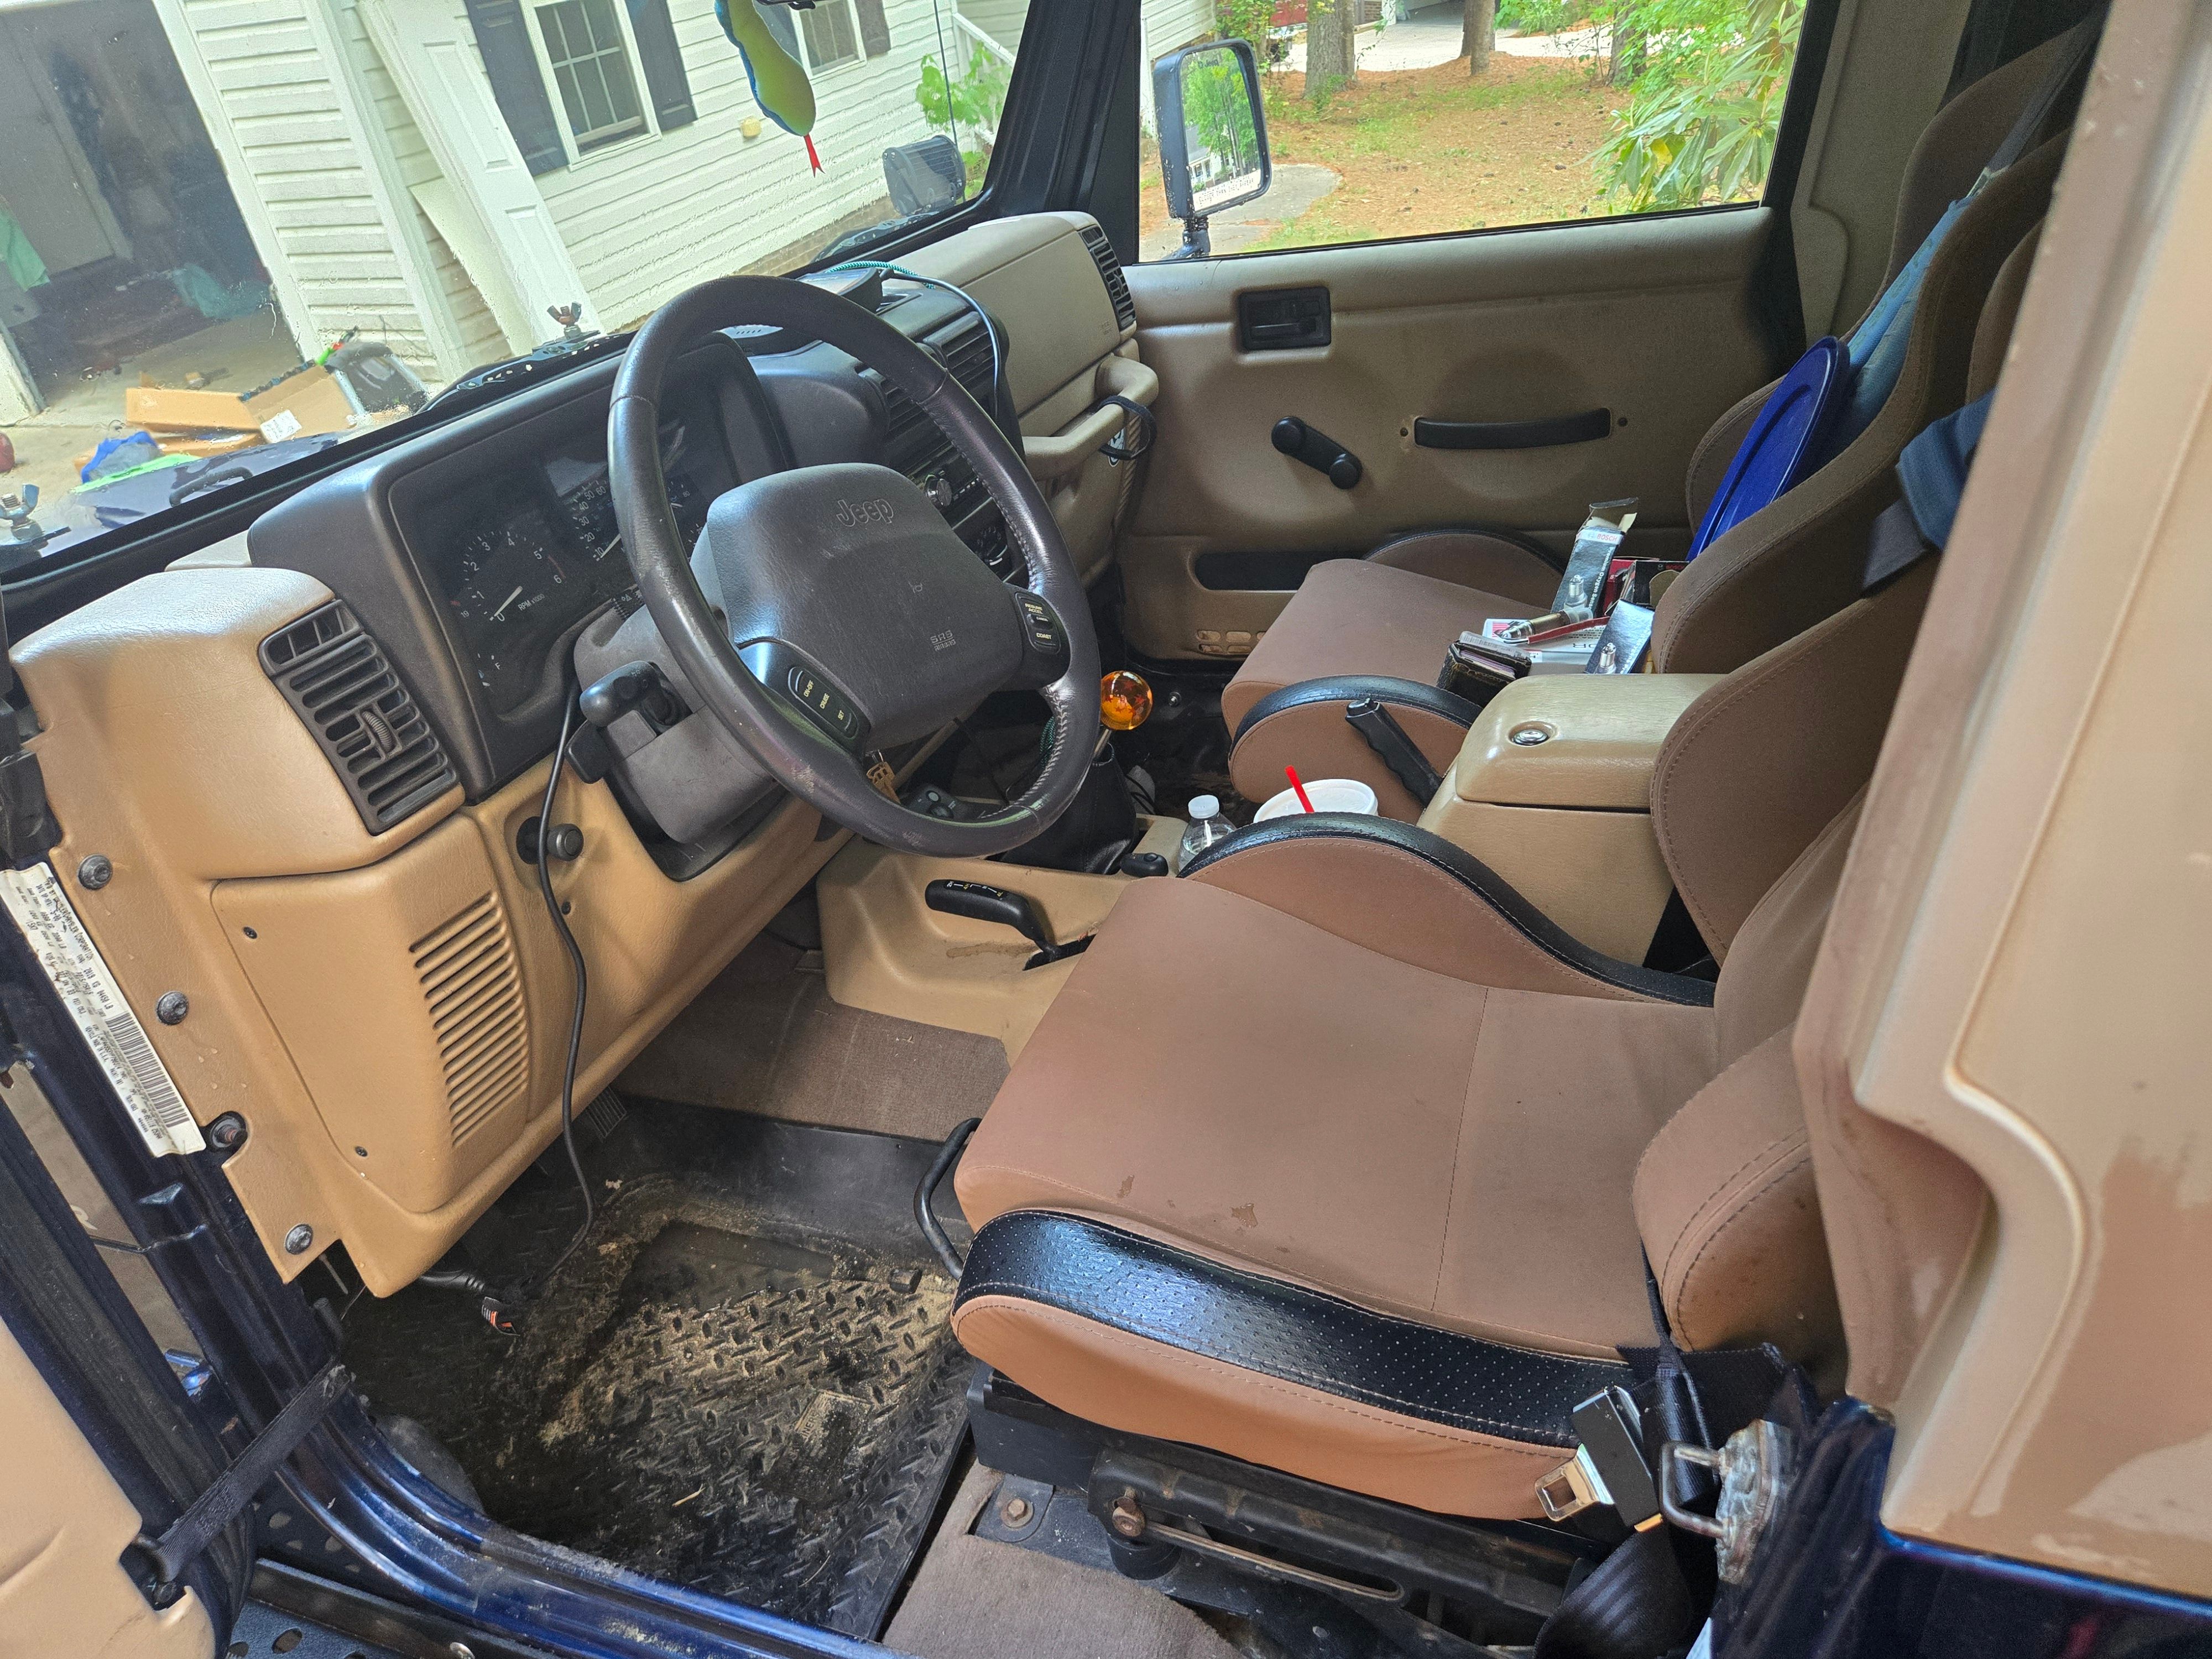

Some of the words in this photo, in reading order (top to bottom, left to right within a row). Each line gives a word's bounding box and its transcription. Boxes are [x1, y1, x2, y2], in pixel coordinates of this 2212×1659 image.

[584, 490, 595, 500] 50
[596, 486, 606, 495] 60
[579, 501, 589, 511] 40
[836, 499, 894, 527] Jeep
[578, 516, 589, 526] 30
[508, 538, 515, 546] 4
[584, 532, 595, 542] 20
[1597, 534, 1618, 542] BOSCH
[482, 541, 491, 551] 3
[533, 550, 543, 560] 5
[470, 562, 480, 571] 2
[554, 575, 562, 584] 6
[477, 590, 485, 599] 1
[518, 599, 532, 611] RPM
[930, 629, 953, 644] SRS
[494, 662, 500, 670] F
[820, 693, 830, 709] CRUISE
